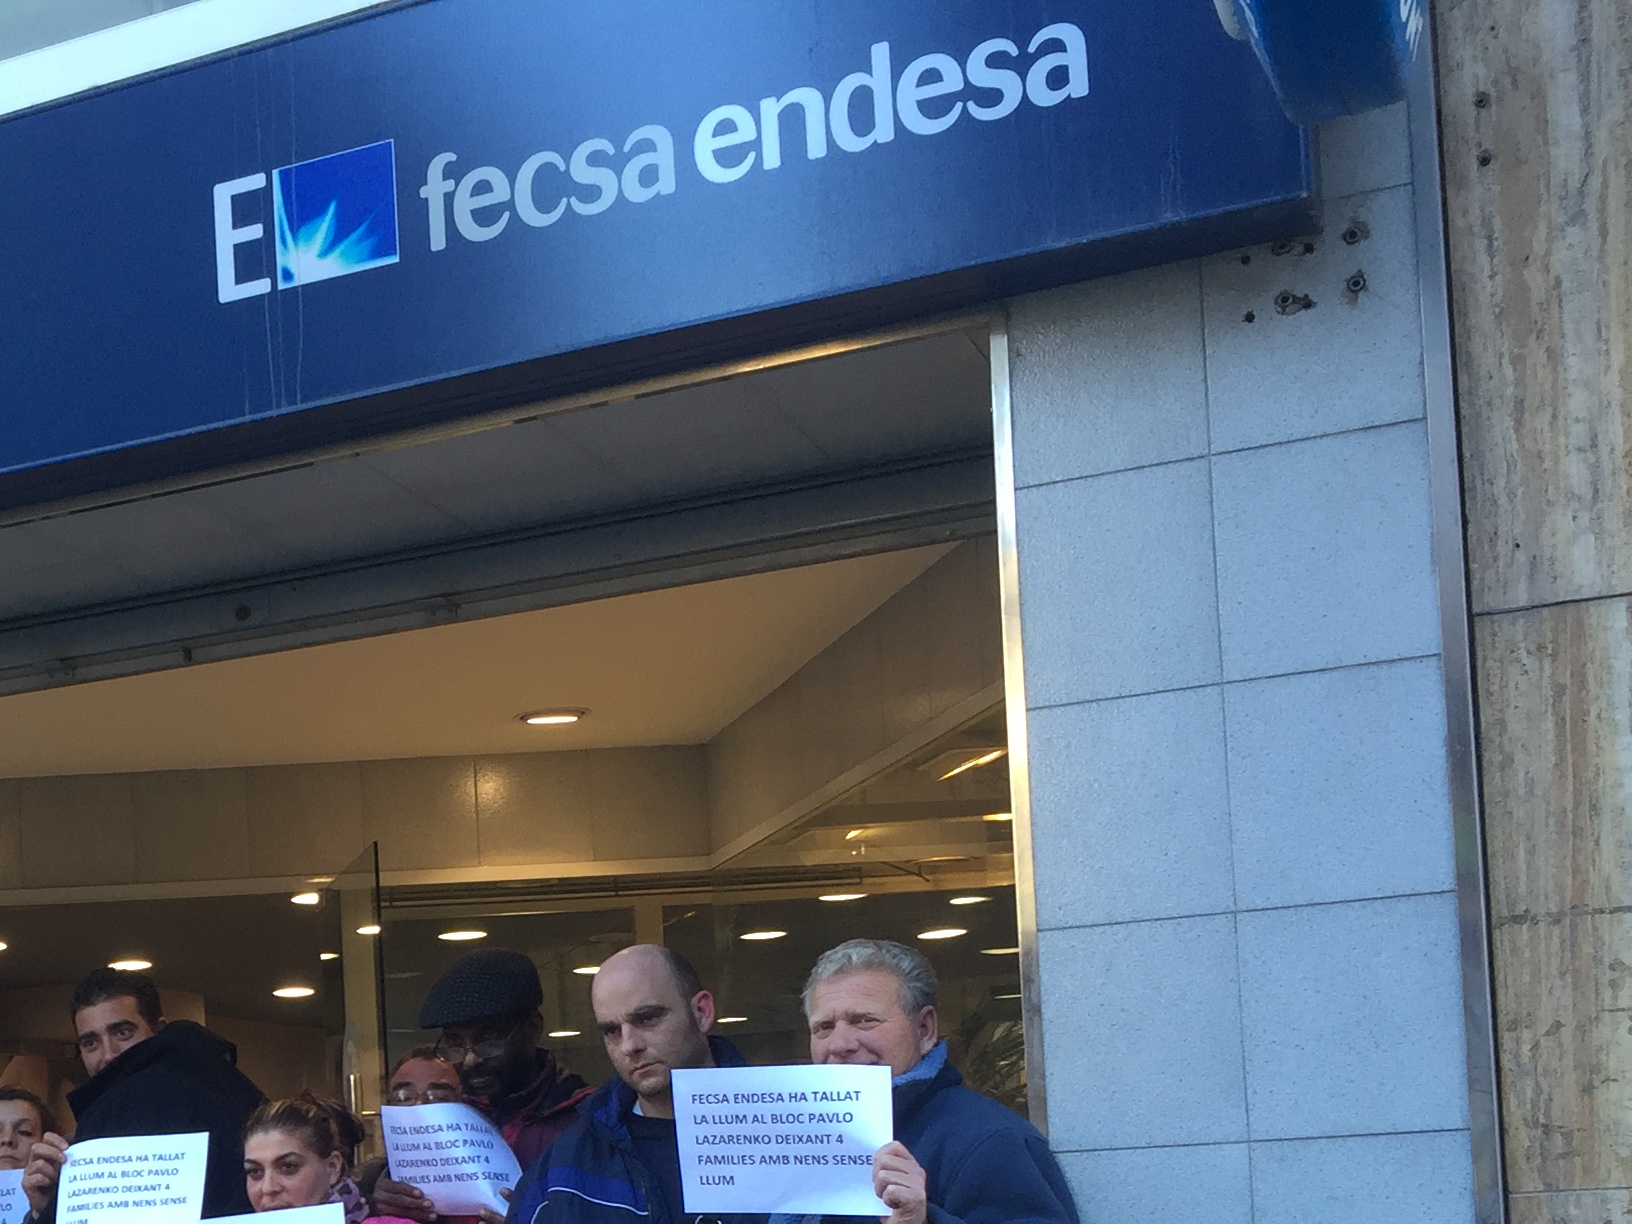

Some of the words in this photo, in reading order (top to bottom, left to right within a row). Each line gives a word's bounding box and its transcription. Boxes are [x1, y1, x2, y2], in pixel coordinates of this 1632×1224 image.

[419, 124, 676, 252] fecsa
[693, 22, 1090, 183] endesa
[692, 1094, 730, 1104] FECSA
[734, 1093, 784, 1104] ENDESA
[788, 1092, 808, 1102] HA
[811, 1091, 861, 1102] TALLAT
[694, 1115, 708, 1124] LA
[712, 1114, 747, 1124] LLUM
[751, 1114, 767, 1124] AL
[771, 1113, 805, 1124] BLOC
[809, 1113, 853, 1123] PAVLO
[696, 1135, 771, 1145] LAZARENKO
[776, 1134, 832, 1145] DEIXANT
[97, 1155, 133, 1164] ENDESA
[136, 1154, 149, 1162] HA
[152, 1153, 185, 1161] TALLAT
[698, 1155, 755, 1165] FAMILIES
[759, 1155, 790, 1165] AMB
[794, 1155, 829, 1165] NENS
[832, 1155, 873, 1166] SENSE
[69, 1174, 77, 1183] LA
[80, 1172, 104, 1181] LLUM
[121, 1170, 144, 1178] BLOC
[148, 1168, 179, 1176] PAVLO
[700, 1175, 735, 1186] LLUM
[68, 1186, 118, 1198] LAZARENKO
[122, 1184, 162, 1193] DEIXANT
[67, 1202, 104, 1213] FAMILIES
[107, 1200, 129, 1209] AMB
[132, 1199, 157, 1207] NENS
[160, 1197, 187, 1206] SENSE
